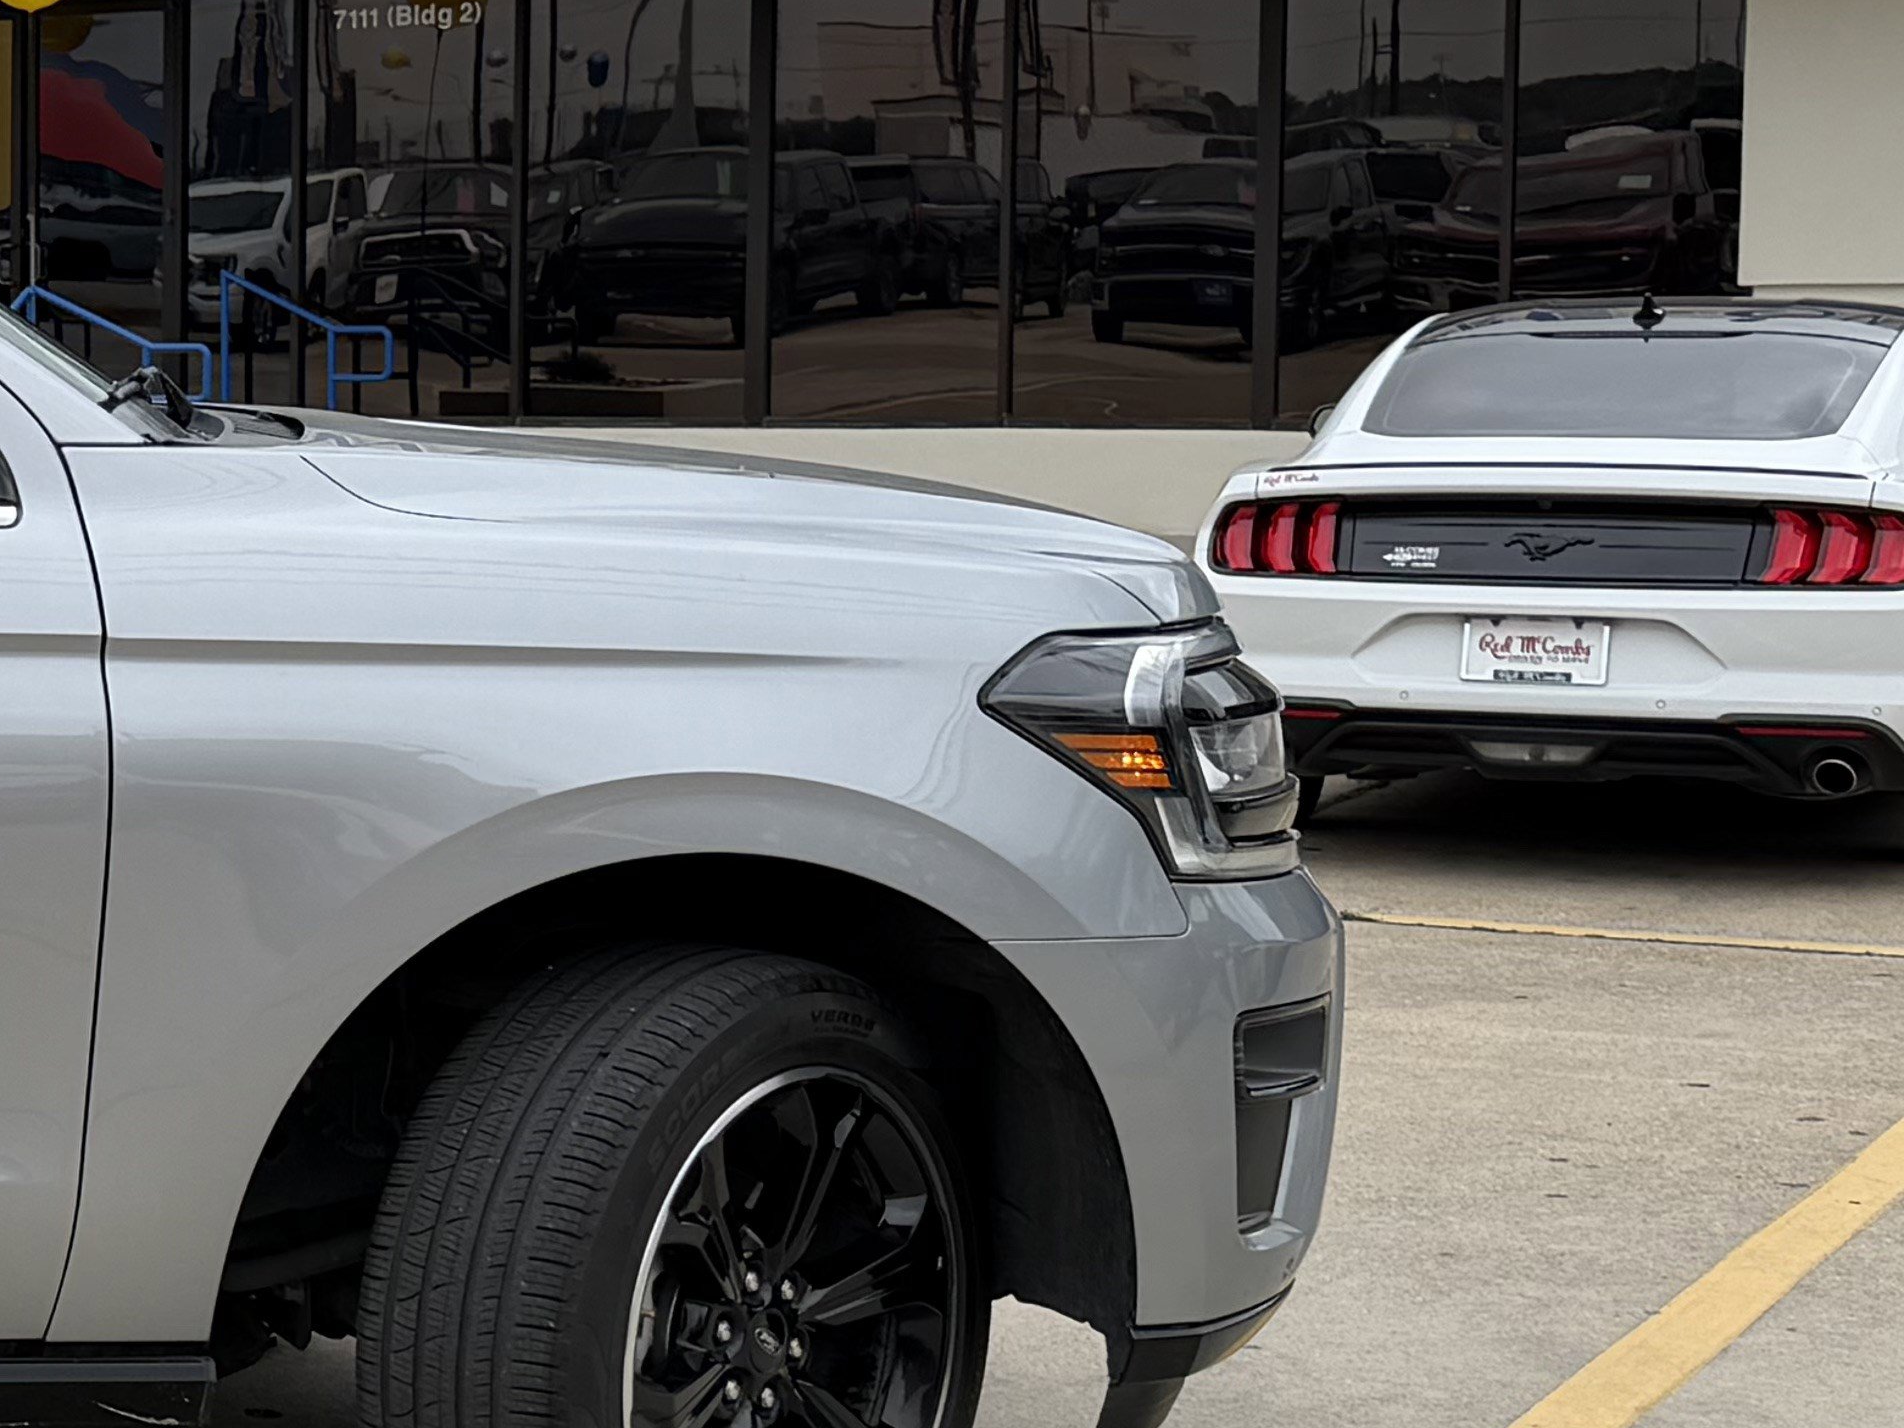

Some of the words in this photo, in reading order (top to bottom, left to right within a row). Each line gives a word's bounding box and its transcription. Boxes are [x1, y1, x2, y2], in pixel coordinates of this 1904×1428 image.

[334, 8, 378, 29] 7111
[387, 4, 452, 29] (Bldg
[459, 1, 482, 24] 2)
[1479, 632, 1513, 660] Red
